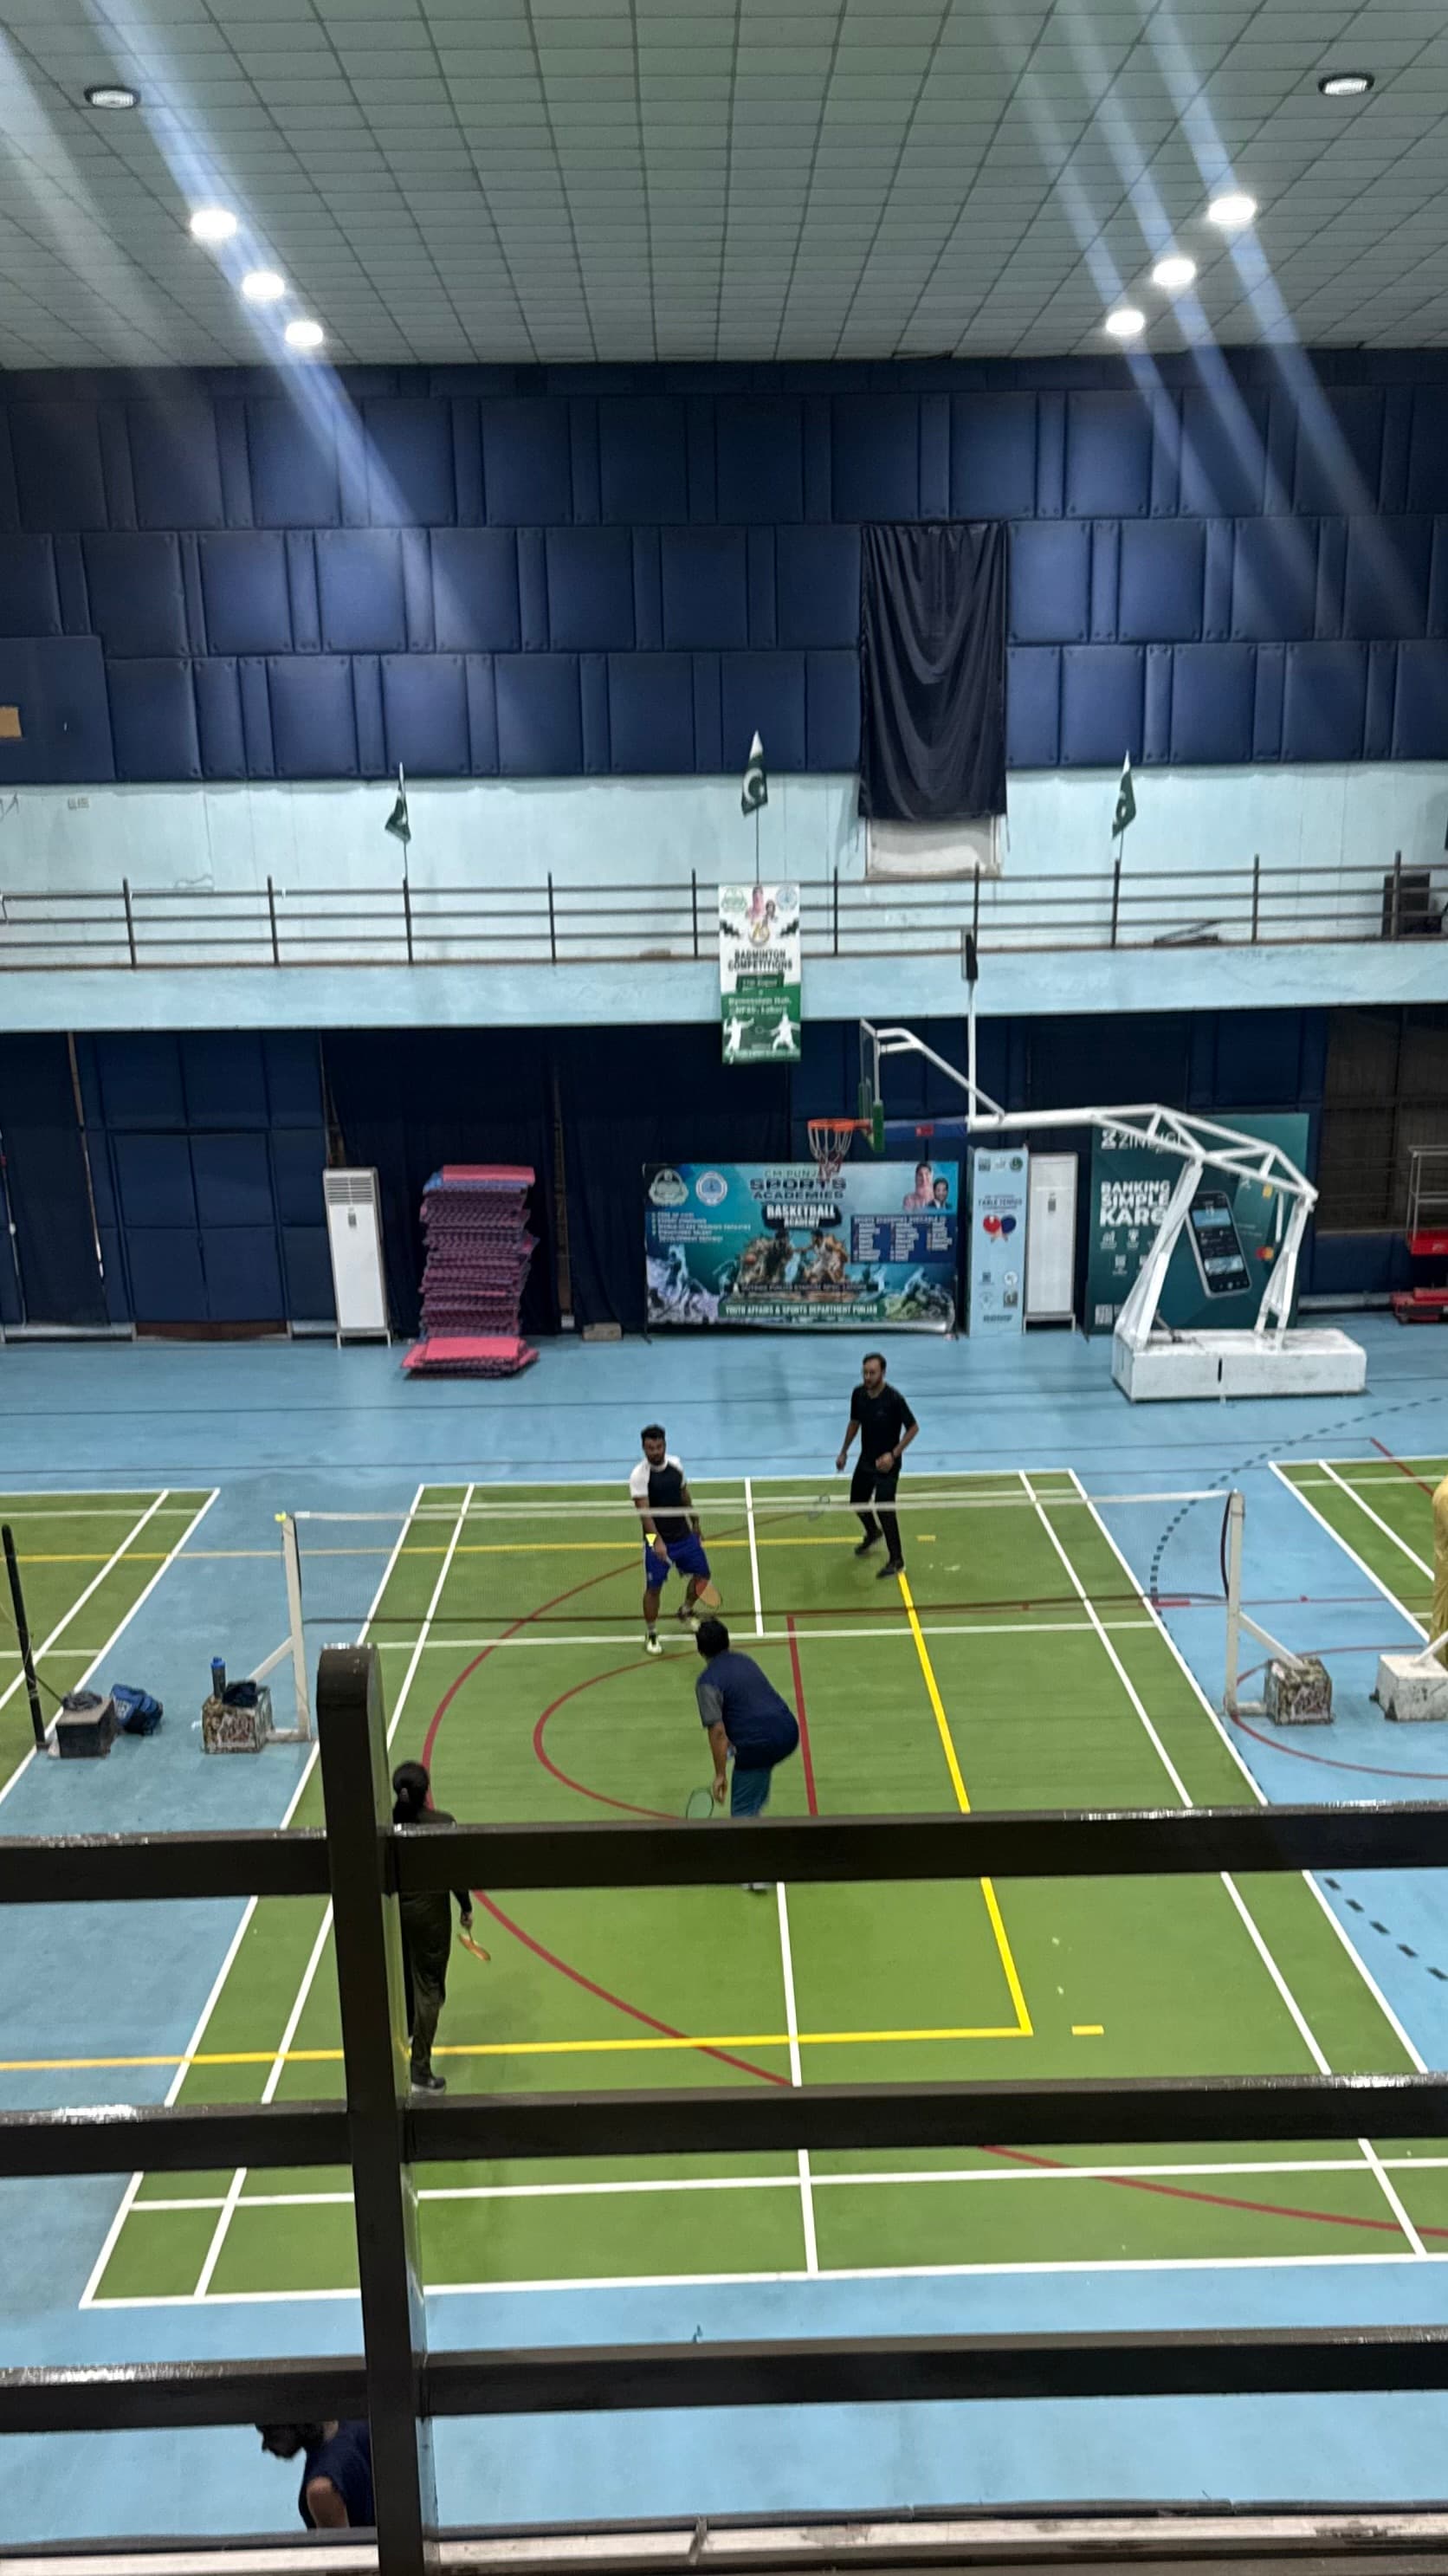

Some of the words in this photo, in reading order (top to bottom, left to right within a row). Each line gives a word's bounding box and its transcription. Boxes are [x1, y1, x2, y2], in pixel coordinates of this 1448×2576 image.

[734, 948, 786, 960] BADMINTON
[727, 959, 792, 971] COMPETITIONS
[750, 1178, 847, 1191] SPORTS
[1101, 1181, 1171, 1194] BANKING
[753, 1191, 844, 1200] ACADEMIES
[1101, 1193, 1170, 1207] SIMPLE
[766, 1203, 836, 1220] BASKETBALL
[1099, 1207, 1167, 1227] KARO
[784, 1217, 819, 1228] ACADEMY
[726, 1304, 747, 1315] YOUTH
[747, 1304, 774, 1315] AFFAIRS
[775, 1304, 781, 1315] &
[782, 1304, 807, 1315] SPORTS
[809, 1304, 851, 1315] DEPARTMENT
[853, 1304, 878, 1315] PUNJAB
